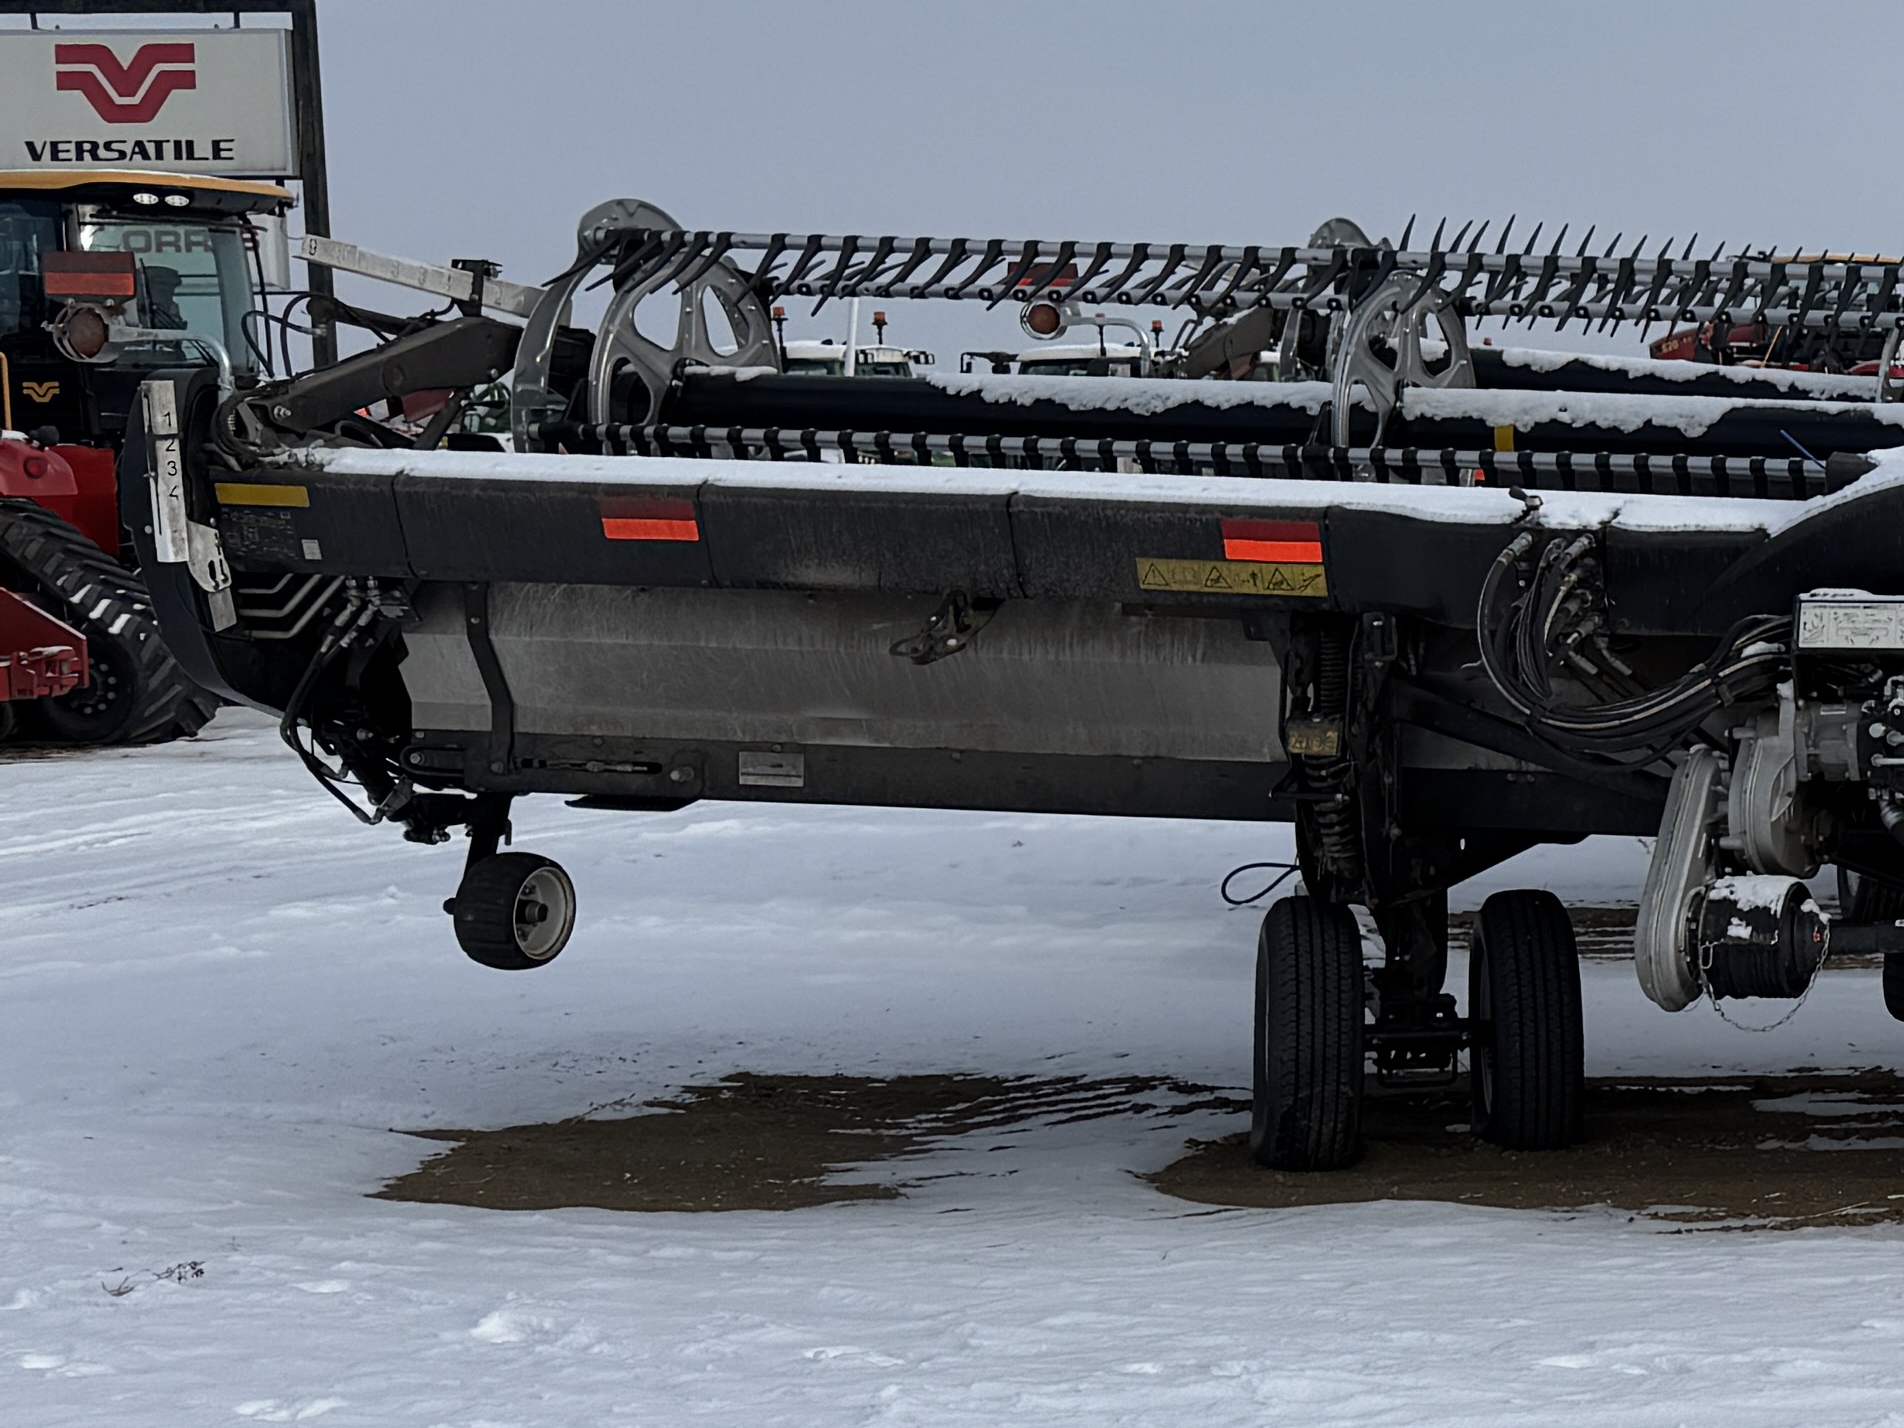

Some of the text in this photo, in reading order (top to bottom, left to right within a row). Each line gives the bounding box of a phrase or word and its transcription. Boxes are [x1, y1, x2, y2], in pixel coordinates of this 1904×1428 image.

[25, 138, 235, 162] VERSATILE
[163, 411, 172, 427] 1
[165, 438, 176, 452] 2
[167, 460, 178, 476] 3
